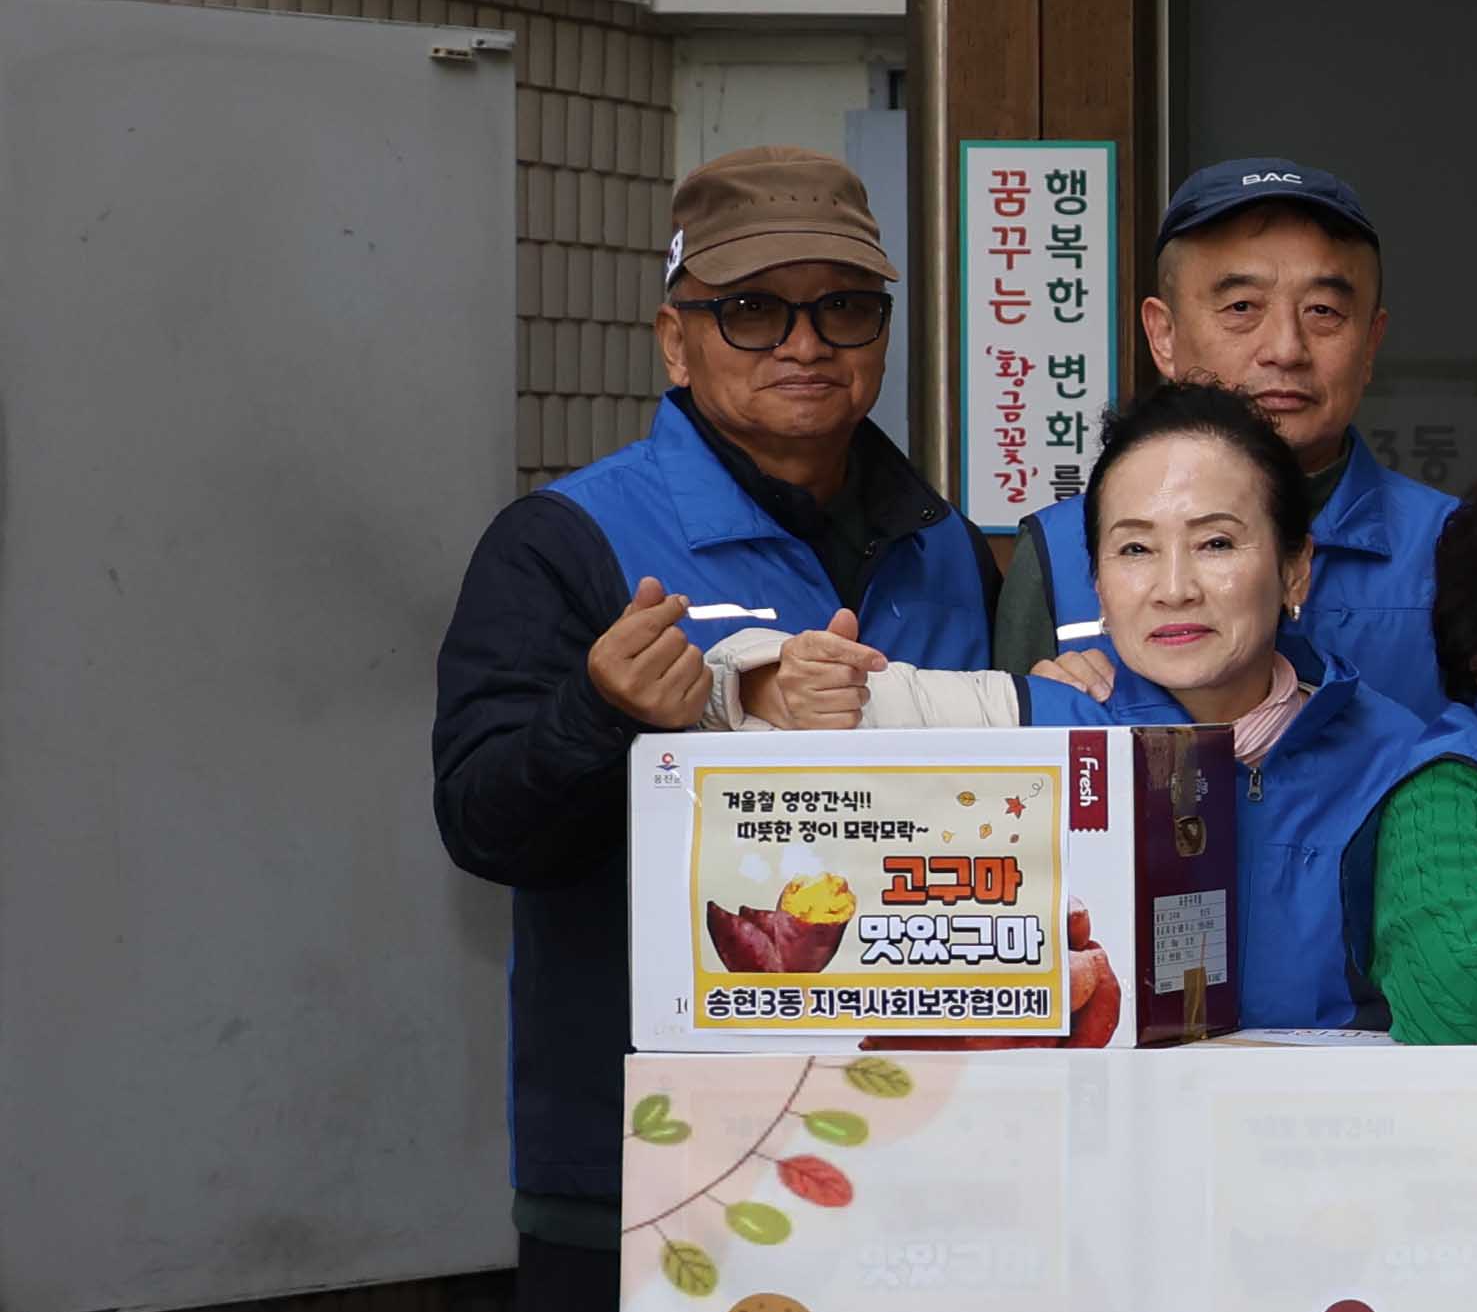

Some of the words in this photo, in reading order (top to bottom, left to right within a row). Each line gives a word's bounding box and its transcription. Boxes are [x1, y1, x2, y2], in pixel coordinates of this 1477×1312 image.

[988, 169, 1032, 325] 꿈꾸는
[1045, 168, 1089, 324] 행복한
[1045, 352, 1089, 500] 변화를
[721, 788, 775, 812] 겨울철
[781, 789, 871, 813] 영양간식!!
[1079, 757, 1099, 807] Fresh
[736, 819, 794, 843] 따뜻한
[799, 820, 838, 843] 정이
[843, 819, 928, 842] 모락모락~
[881, 855, 1022, 907] 고구마
[858, 915, 1045, 965] 맛있구마
[705, 988, 802, 1017] 송현3동
[810, 987, 1049, 1017] 지역사회보장협의체
